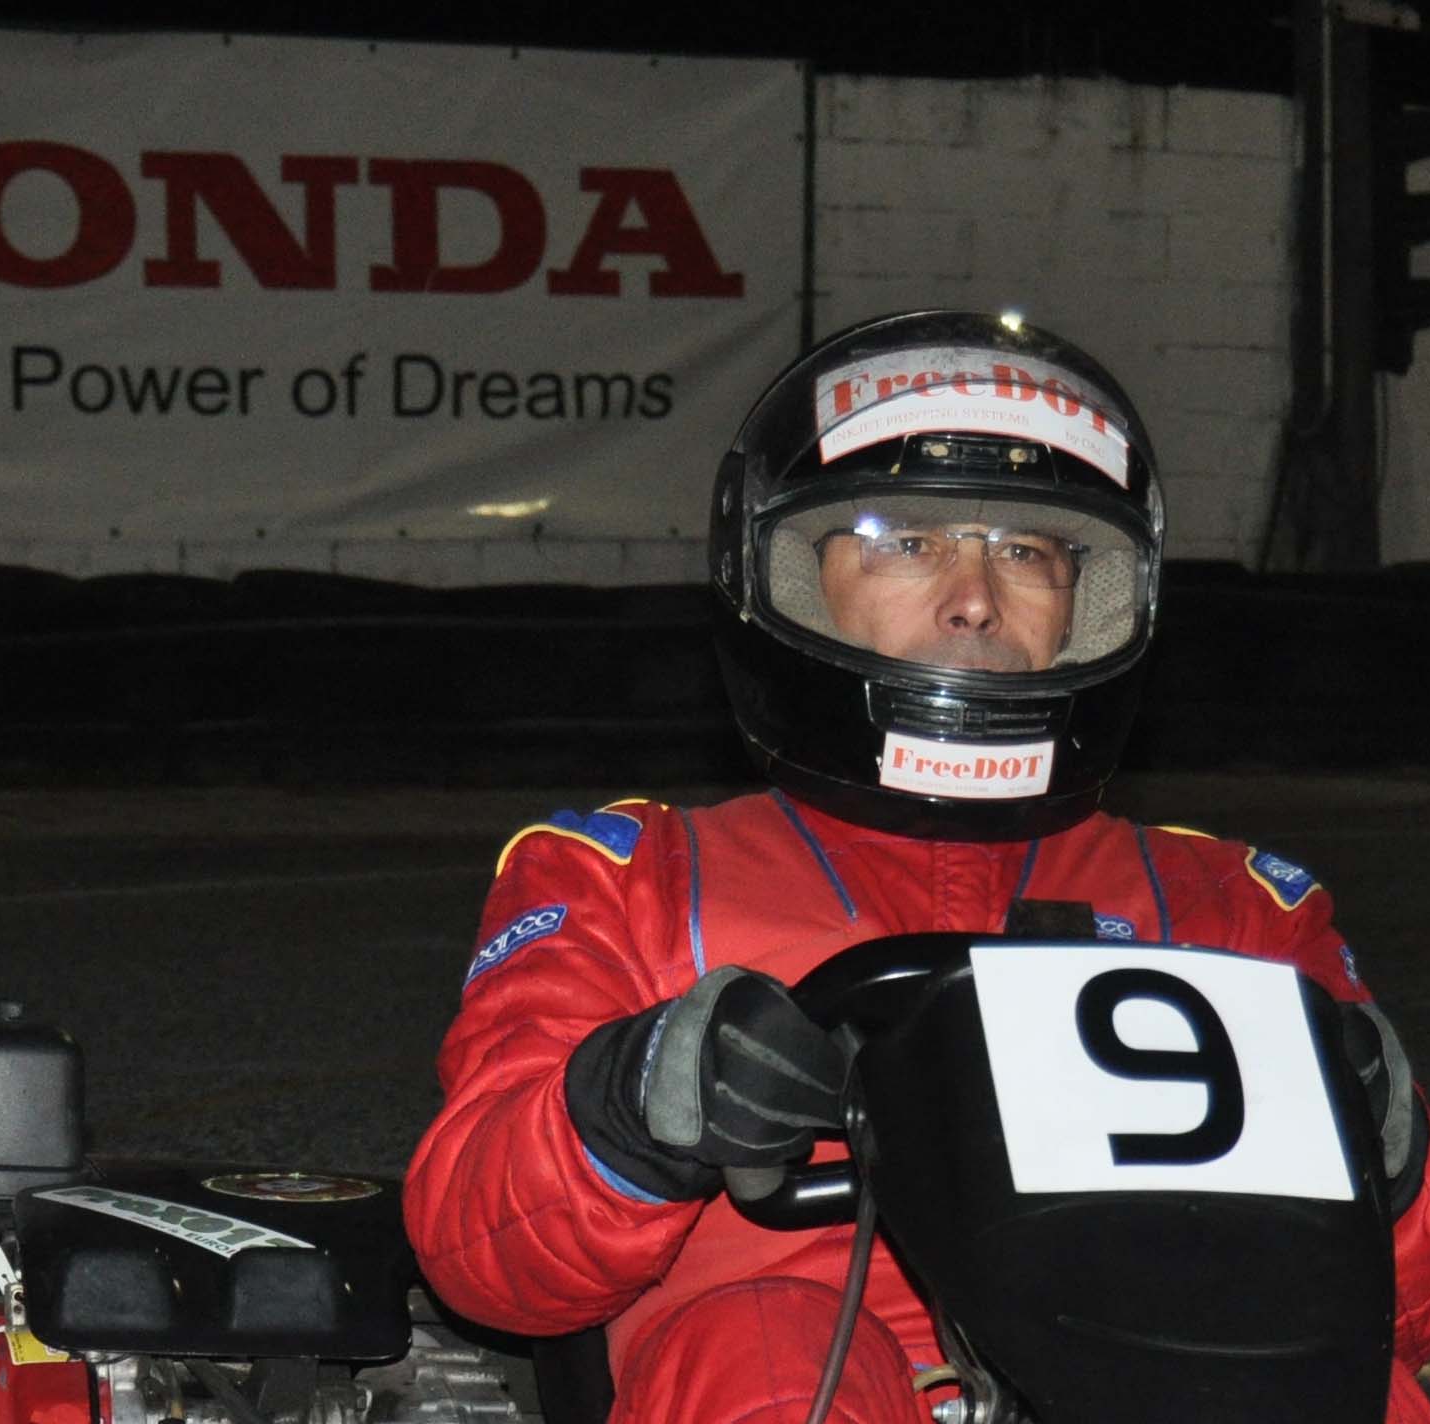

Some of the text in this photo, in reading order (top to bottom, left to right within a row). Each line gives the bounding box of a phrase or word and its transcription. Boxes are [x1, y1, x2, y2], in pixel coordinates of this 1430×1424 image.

[12, 345, 265, 417] Power
[291, 352, 368, 419] of
[392, 354, 675, 421] Dreams
[832, 363, 1111, 436] FreeDOT
[892, 747, 1044, 780] FreeDOT
[1074, 967, 1246, 1167] 9
